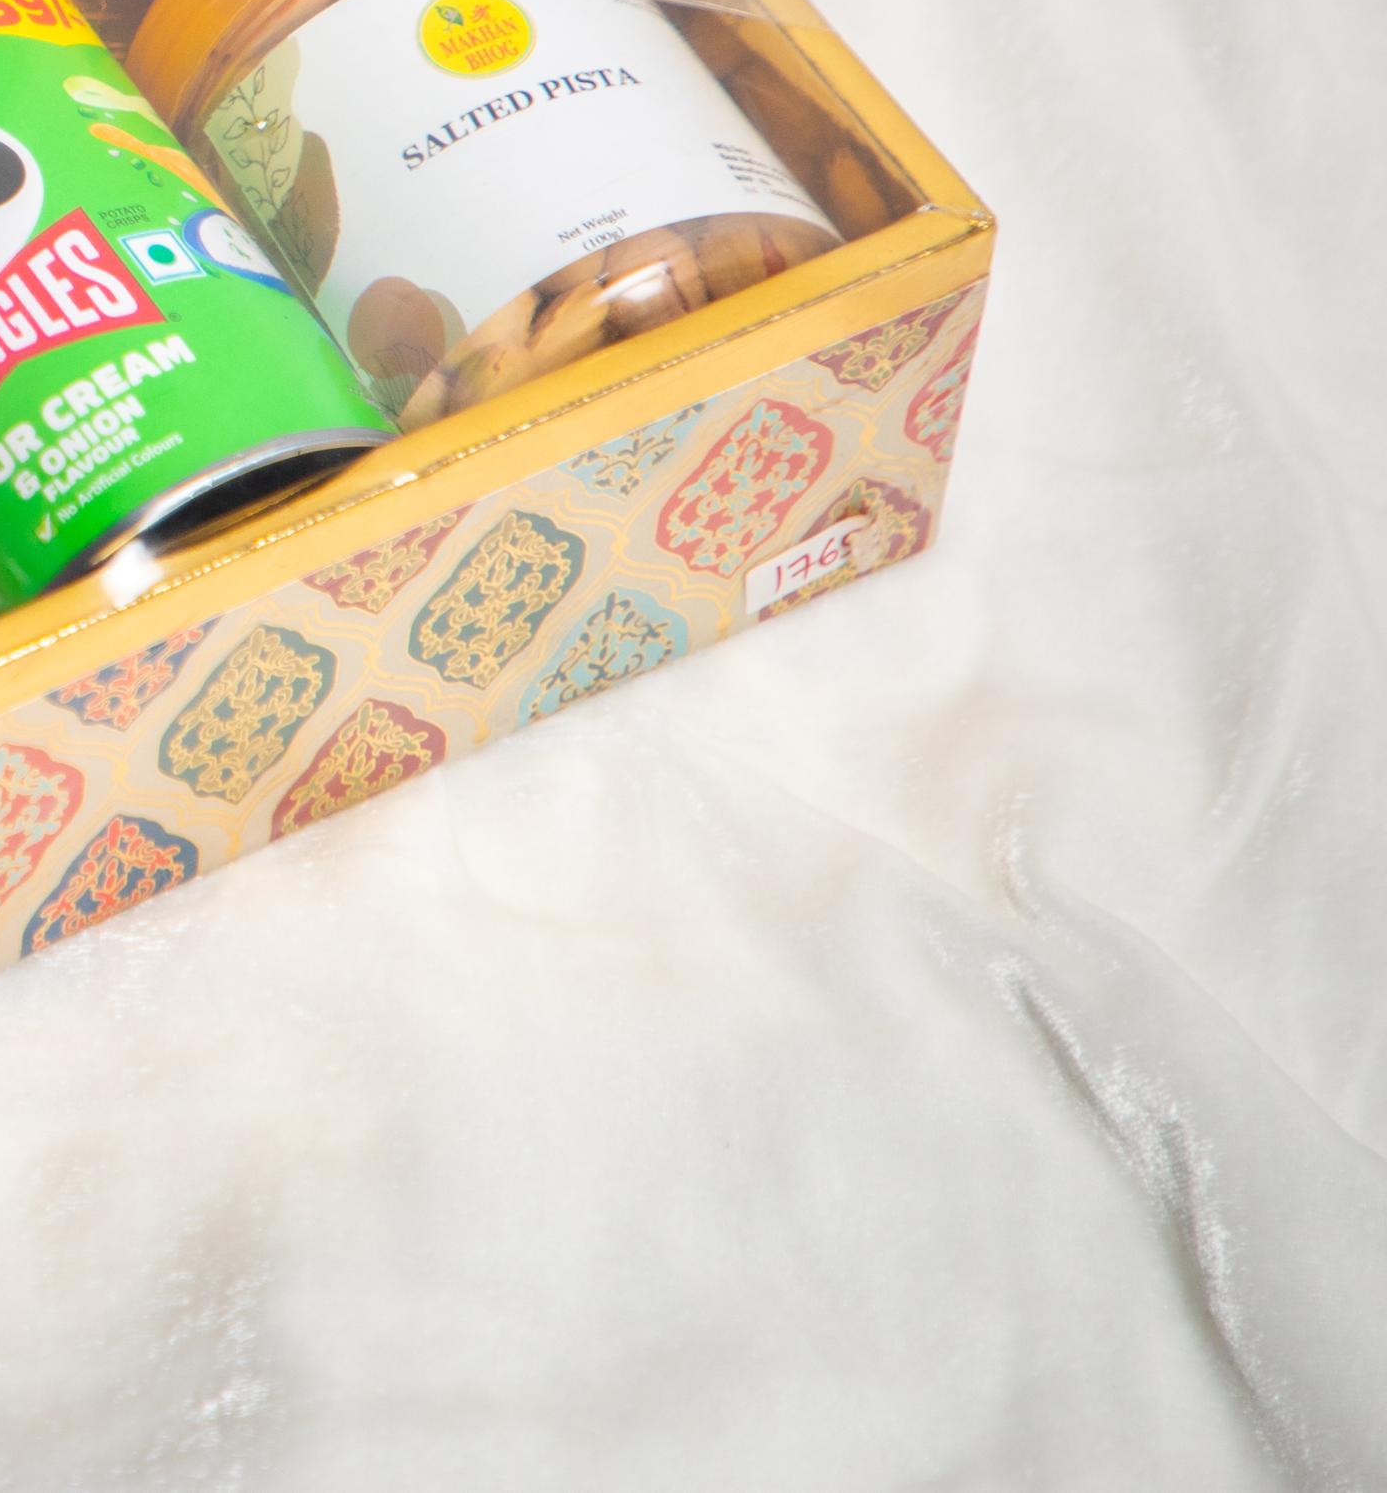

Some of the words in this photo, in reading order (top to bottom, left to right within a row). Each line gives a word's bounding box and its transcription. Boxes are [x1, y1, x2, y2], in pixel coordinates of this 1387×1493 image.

[439, 17, 520, 59] MAKHAN
[464, 38, 520, 73] BHOG
[401, 89, 534, 171] SALTED
[538, 66, 642, 101] PISTA
[98, 203, 147, 222] POTATO
[106, 212, 151, 230] CRISPS
[557, 227, 582, 244] Net
[581, 206, 629, 234] Weight
[40, 334, 196, 432] CREAM
[12, 470, 41, 500] &
[39, 394, 146, 477] ONION
[42, 426, 140, 503] FLAVOUR
[57, 502, 77, 524] No
[78, 462, 133, 504] Artificial
[129, 432, 184, 472] Colours
